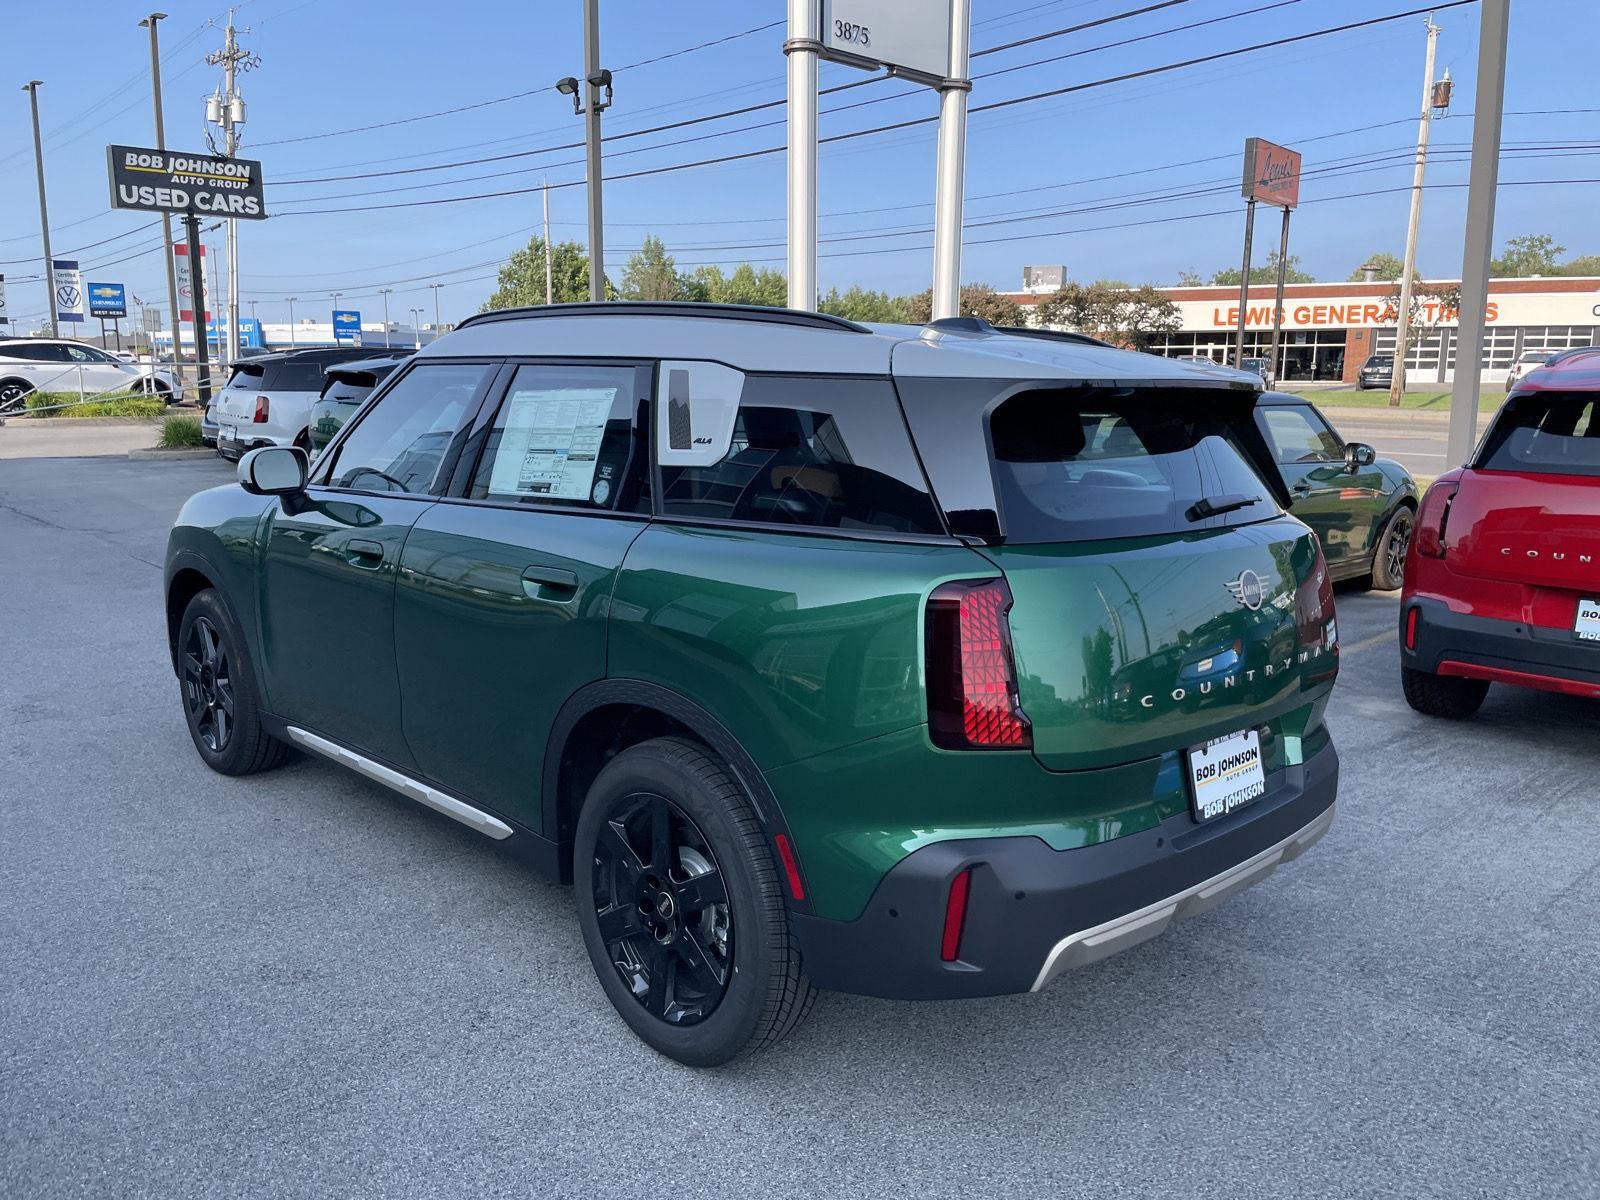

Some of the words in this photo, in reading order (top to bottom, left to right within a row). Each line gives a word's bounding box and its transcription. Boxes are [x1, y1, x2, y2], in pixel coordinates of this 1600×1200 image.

[835, 19, 869, 44] 3875
[125, 152, 163, 168] BOB
[166, 157, 250, 177] JOHNSON
[171, 175, 204, 185] AUTO
[209, 179, 249, 189] GROUP
[119, 184, 190, 208] USED
[195, 191, 260, 215] CARS
[1213, 307, 1286, 326] LEWIS
[1294, 304, 1414, 325] GENERA
[1244, 584, 1260, 596] MINI
[1581, 610, 1600, 619] BO
[1196, 764, 1216, 782] BOB
[1218, 747, 1258, 777] JOHNSON
[1226, 772, 1240, 782] AUTO
[1203, 798, 1224, 818] BOB
[1224, 780, 1265, 814] JOHNSON
